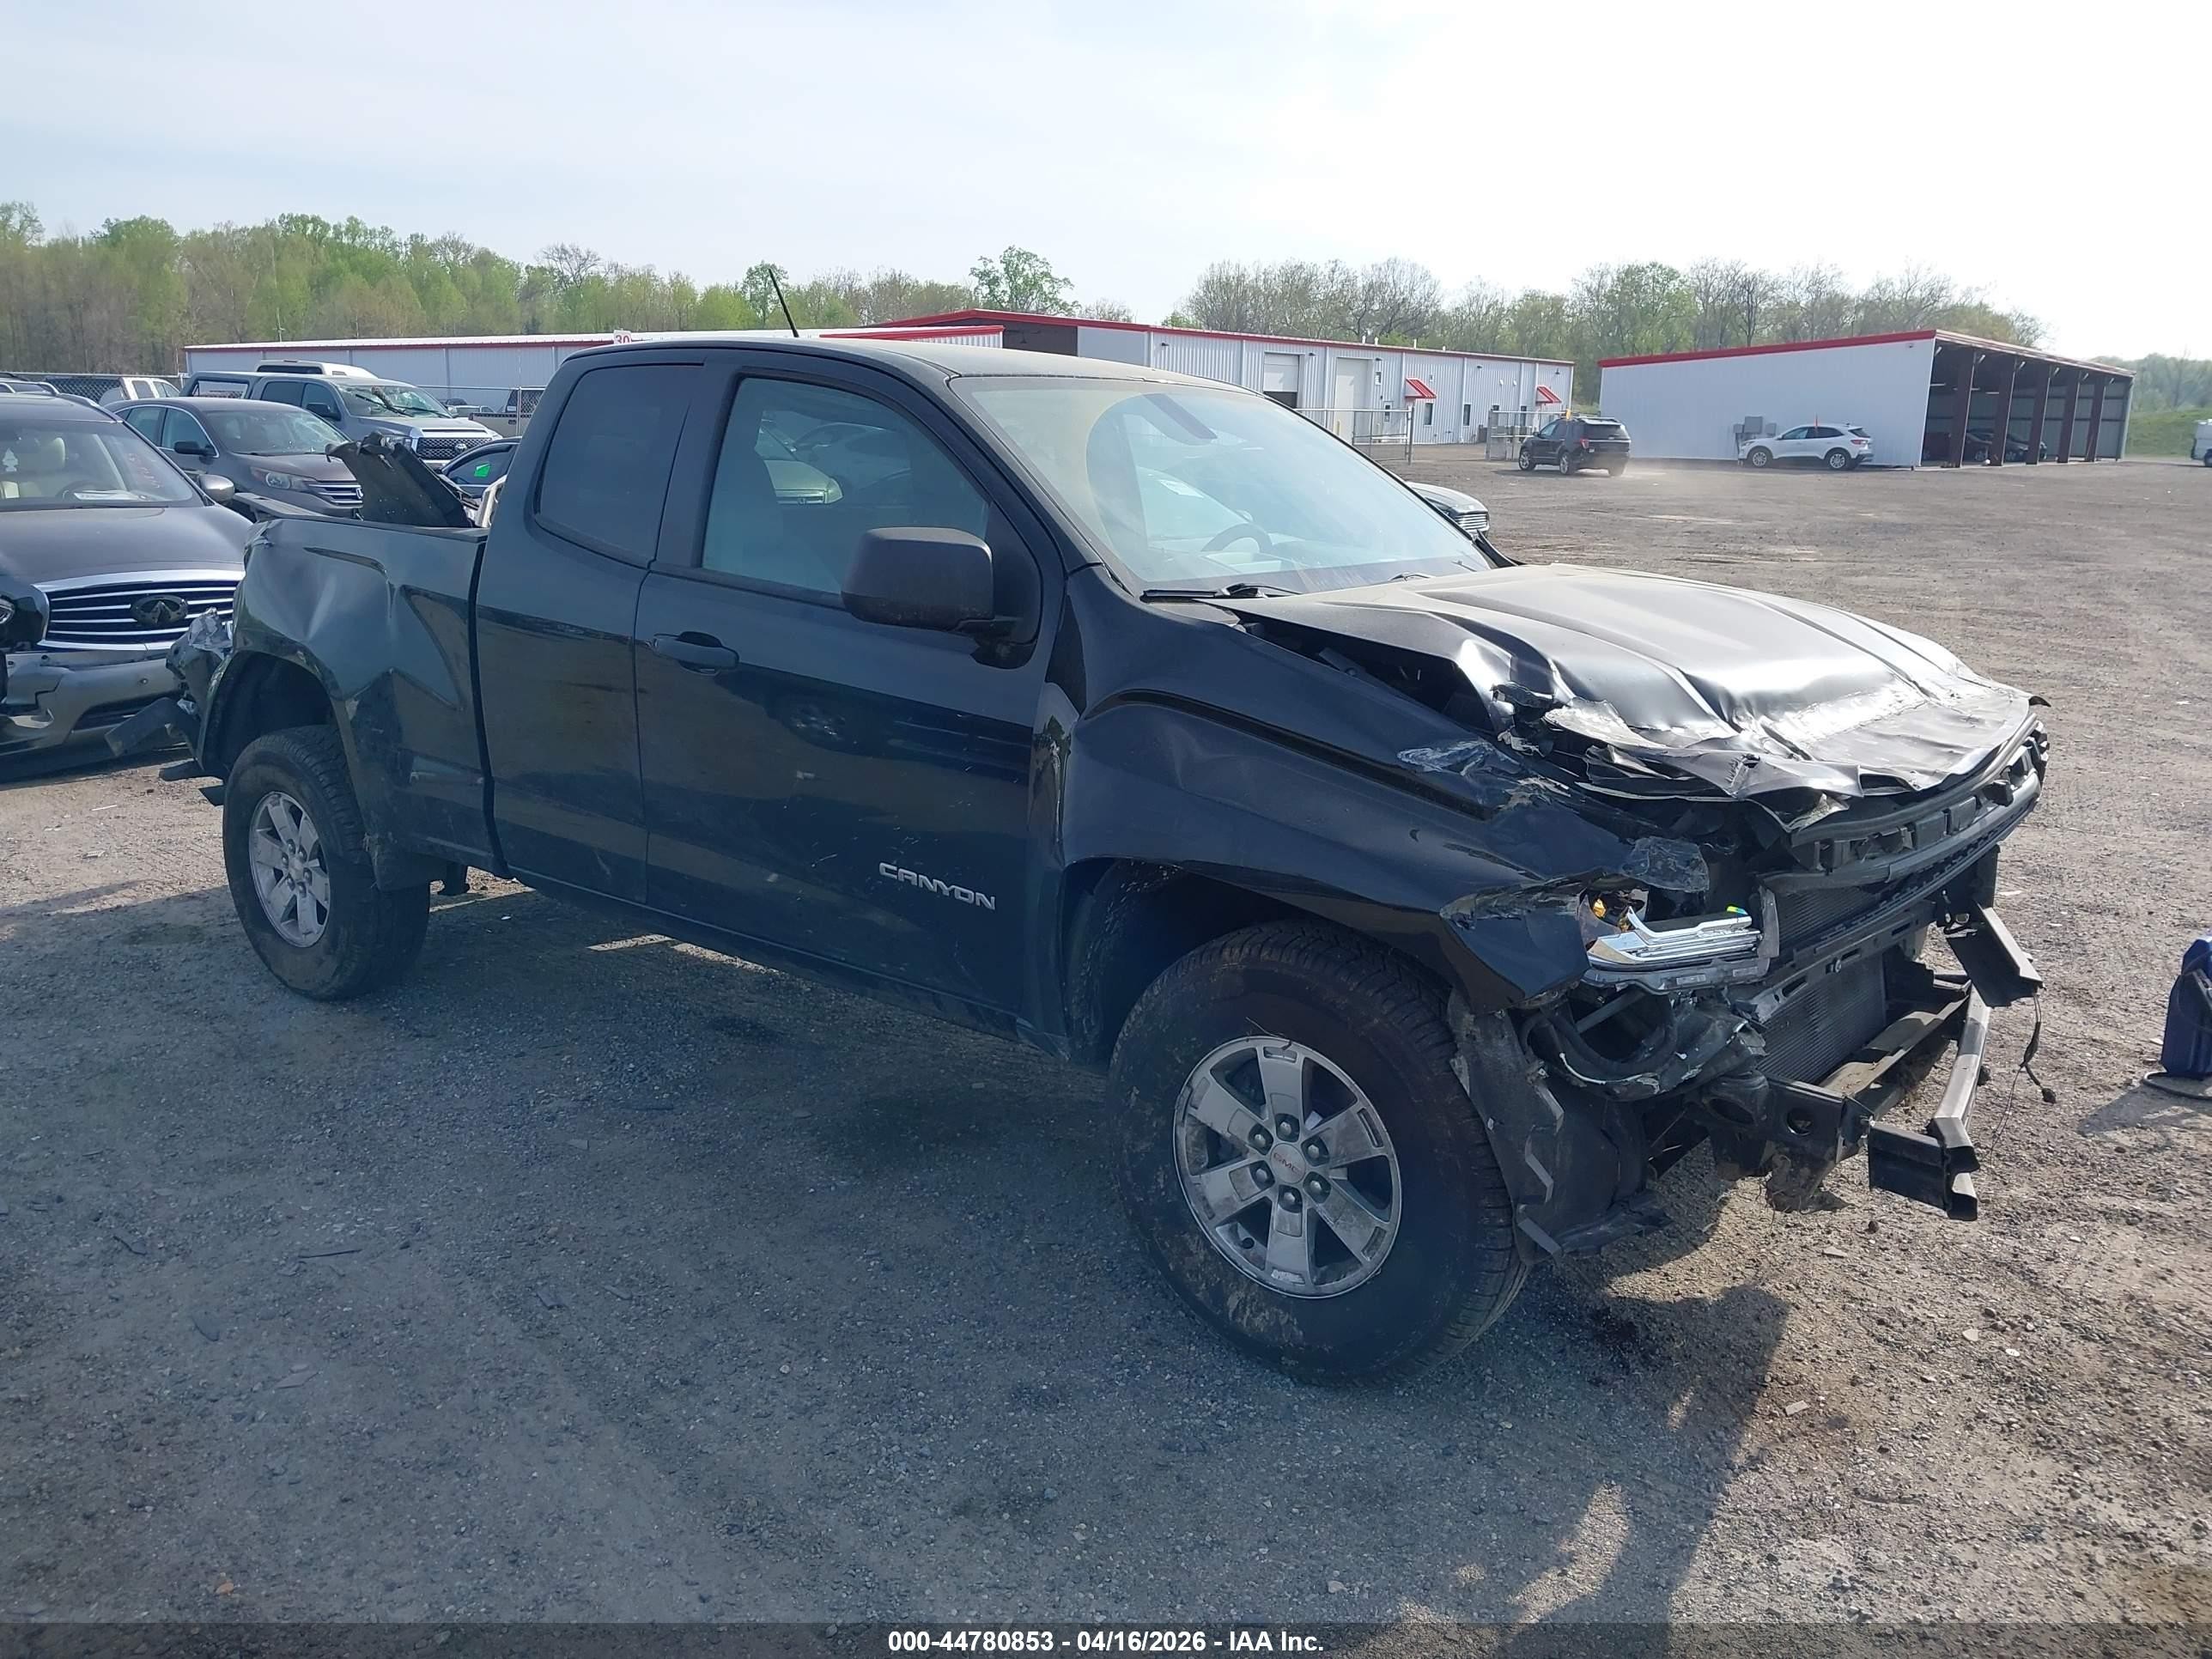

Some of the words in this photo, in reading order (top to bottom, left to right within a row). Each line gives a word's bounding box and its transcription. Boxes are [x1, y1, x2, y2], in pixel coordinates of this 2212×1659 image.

[615, 334, 629, 343] 30
[879, 862, 995, 910] CANYON
[1273, 1152, 1300, 1176] GMC
